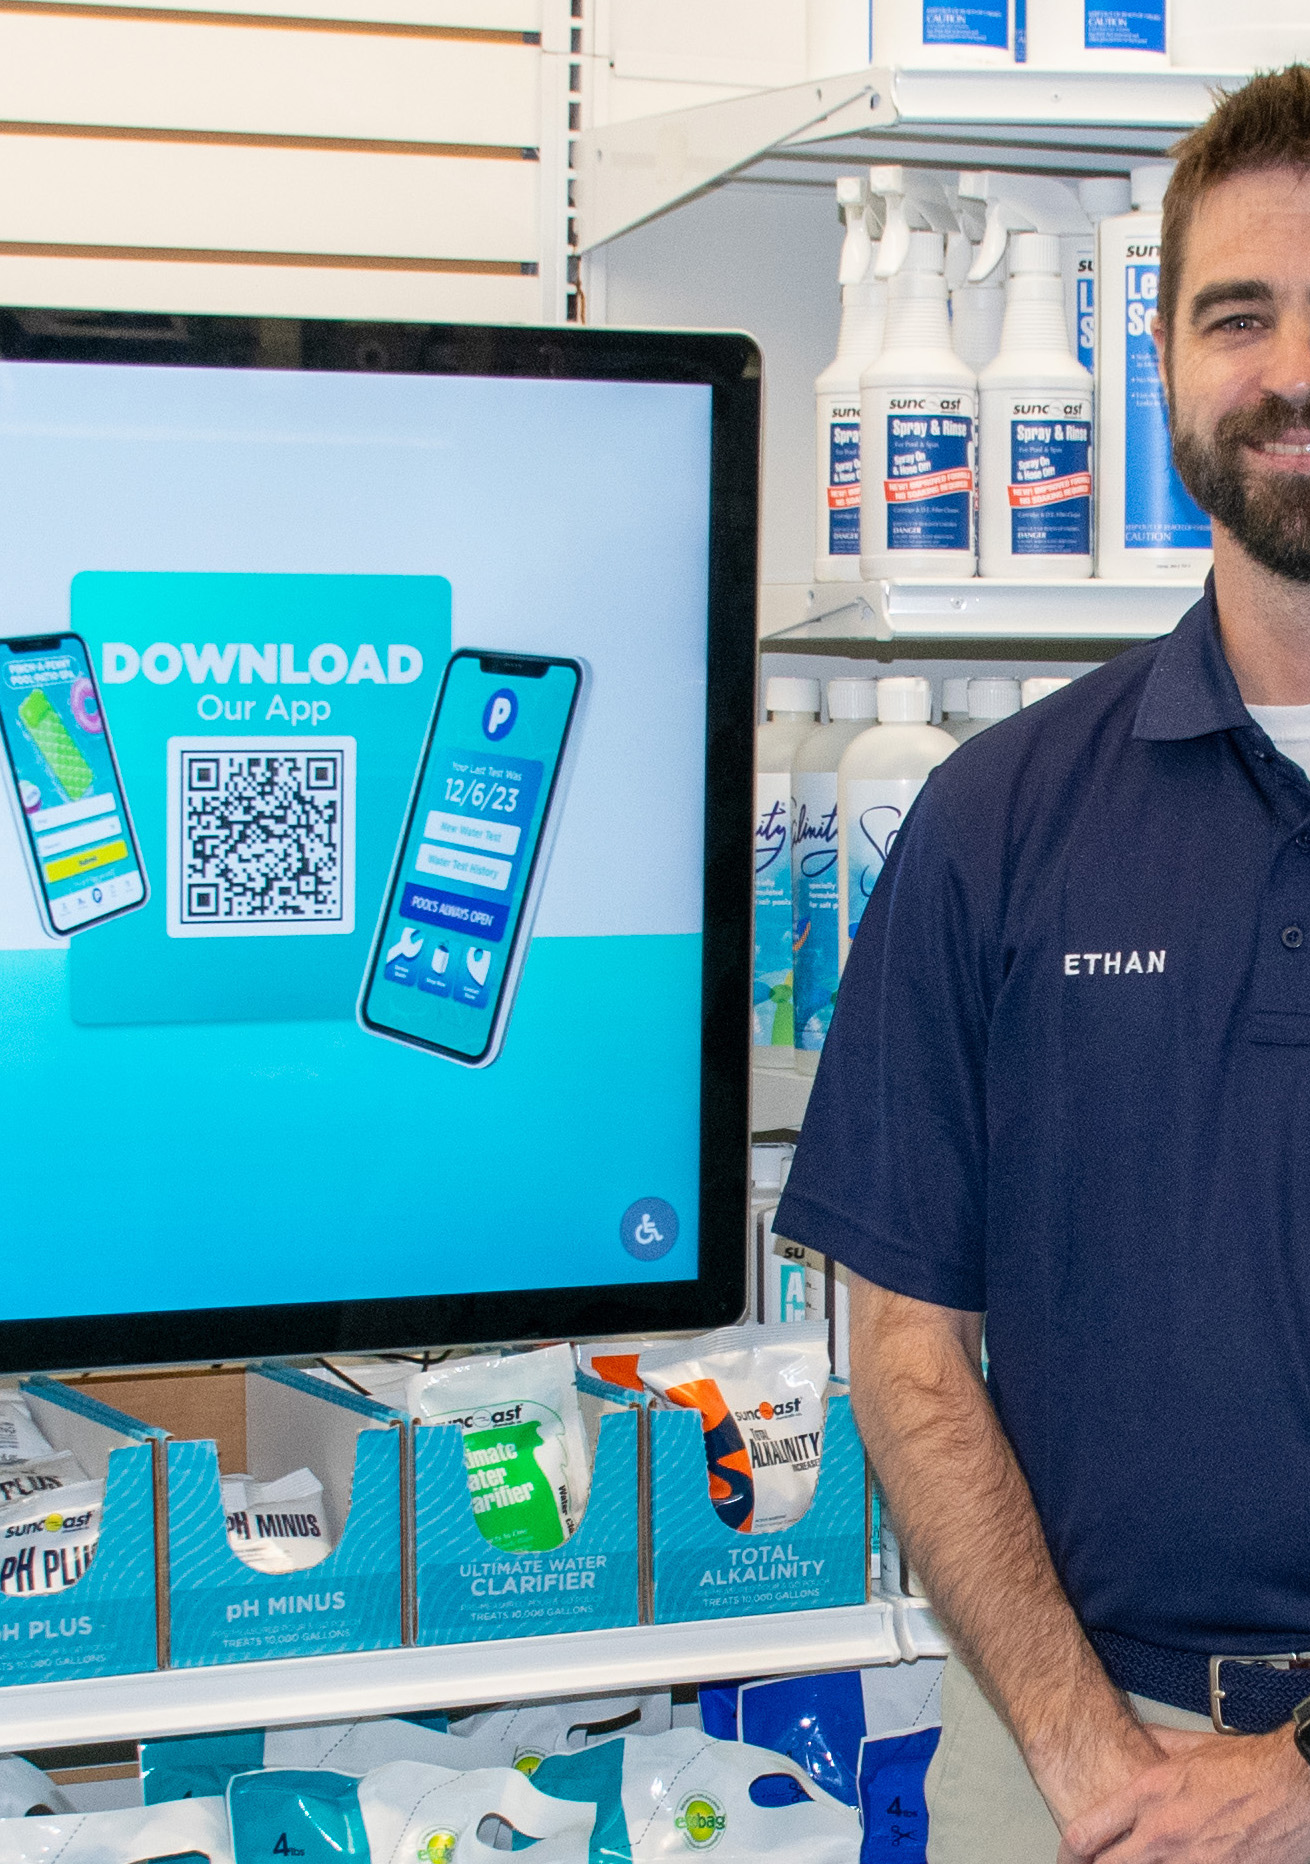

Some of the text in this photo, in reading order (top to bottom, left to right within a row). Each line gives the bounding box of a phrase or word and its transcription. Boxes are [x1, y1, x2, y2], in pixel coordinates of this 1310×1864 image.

[834, 427, 860, 445] Spra
[893, 418, 967, 438] Spray & Rinse
[1016, 424, 1052, 443] Spray
[1054, 425, 1064, 442] &
[1126, 532, 1172, 542] CAUTION
[102, 642, 424, 685] DOWNLOAD
[197, 693, 331, 726] Our App
[488, 697, 511, 734] P
[470, 764, 485, 776] Last
[488, 766, 504, 779] Test
[506, 769, 522, 781] Was
[445, 777, 520, 813] 12/6/23
[460, 825, 484, 838] Water
[485, 829, 502, 843] Test
[428, 854, 499, 880] Water Test History
[1064, 949, 1167, 976] ETHAN
[750, 1432, 821, 1469] ALKALINITY
[792, 1458, 821, 1471] INCREASE
[468, 1467, 507, 1493] ater
[472, 1481, 534, 1514] arifier
[558, 1485, 569, 1516] Water
[255, 1513, 321, 1538] MINUS
[43, 1543, 98, 1589] PLU
[460, 1555, 607, 1577] ULTIMATE WATER
[728, 1543, 800, 1566] TOTAL
[470, 1572, 596, 1597] CLARIFIER
[700, 1559, 825, 1587] ALKALINITY
[226, 1591, 346, 1623] pH MINUS
[703, 1596, 740, 1607] TREATS
[774, 1588, 820, 1601] GALLONS
[471, 1611, 508, 1621] TREATS
[547, 1606, 594, 1617] GALLONS
[29, 1617, 93, 1640] PLUS
[223, 1638, 262, 1648] TREATS
[302, 1629, 350, 1641] GALLONS
